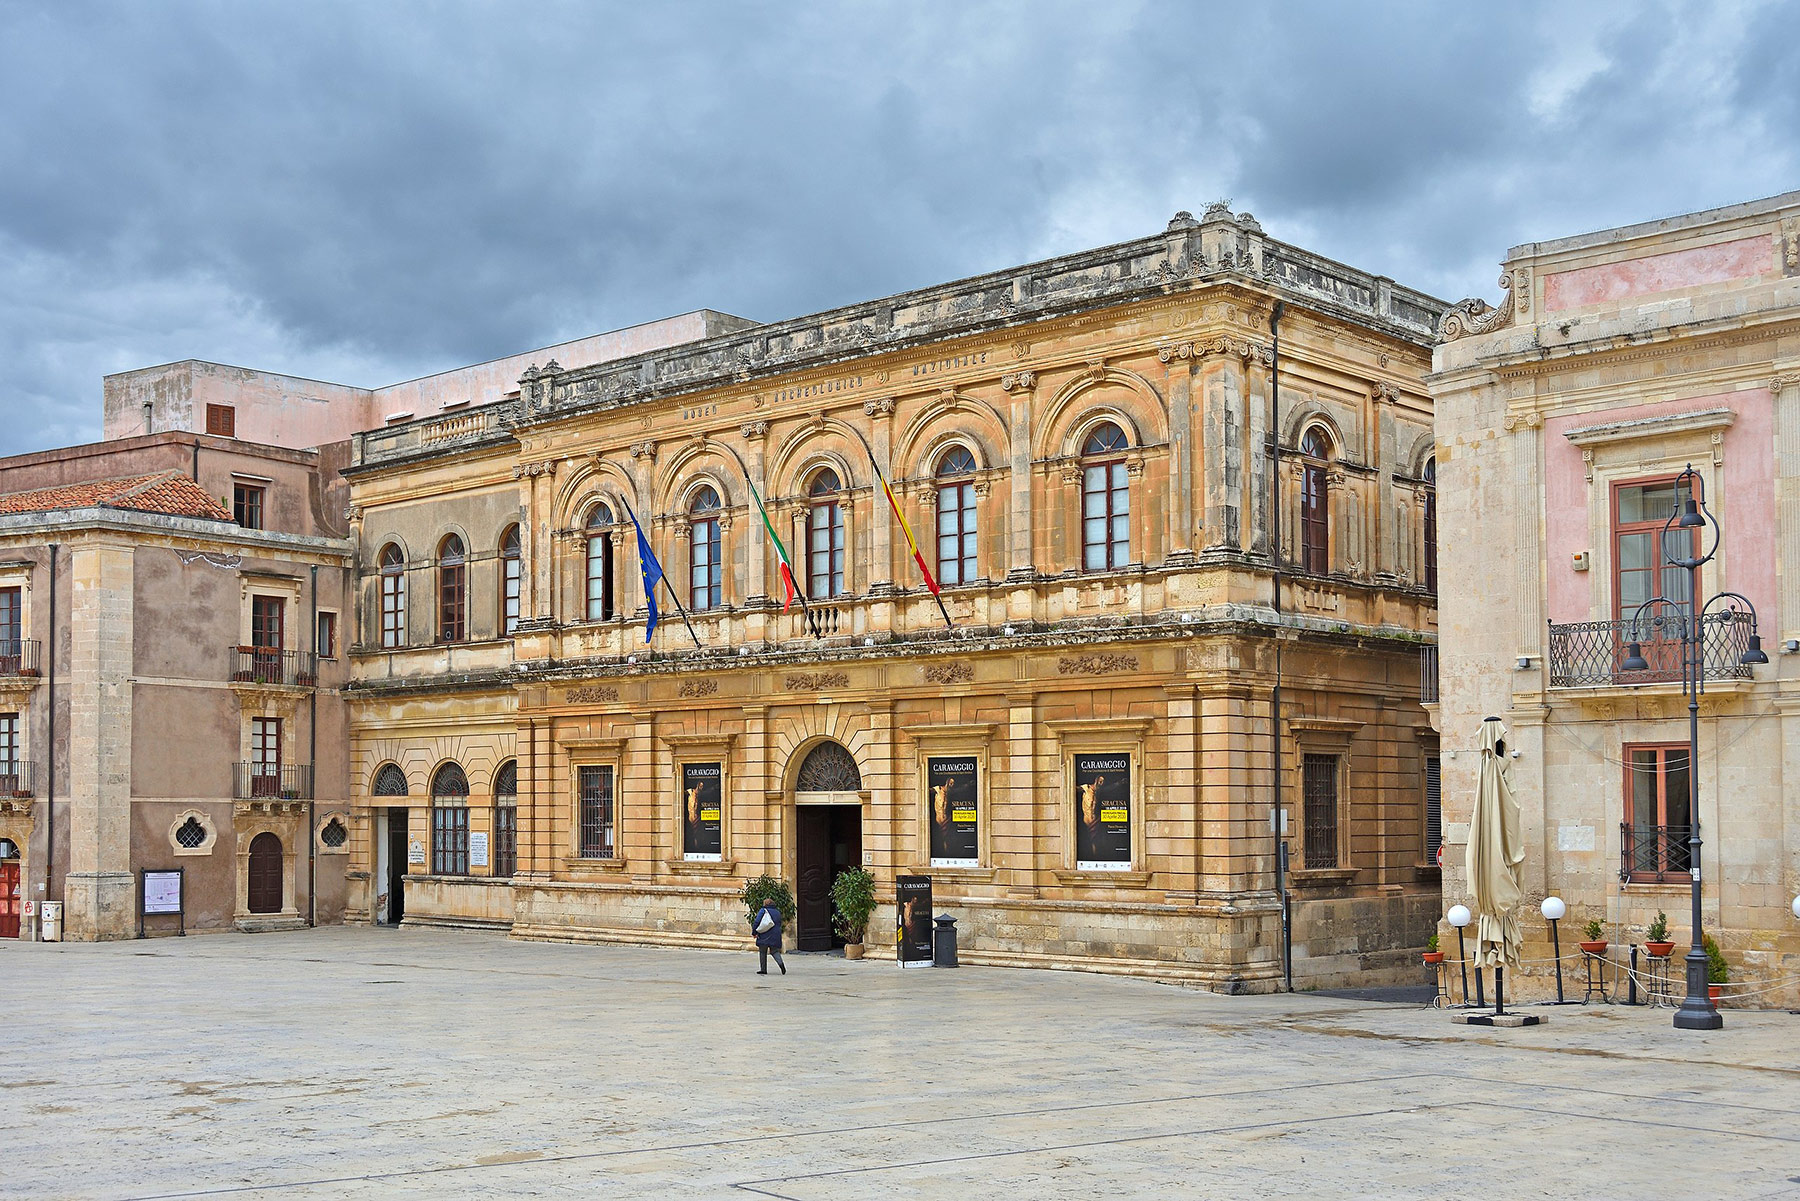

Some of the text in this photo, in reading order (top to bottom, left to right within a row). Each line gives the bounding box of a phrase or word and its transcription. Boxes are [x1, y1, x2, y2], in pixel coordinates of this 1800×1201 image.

[683, 352, 987, 420] MUSEO ARCHEOLOGICO NAZIONALE
[933, 763, 974, 771] CARAVAGGIO
[1080, 760, 1127, 769] CARAVAGGIO
